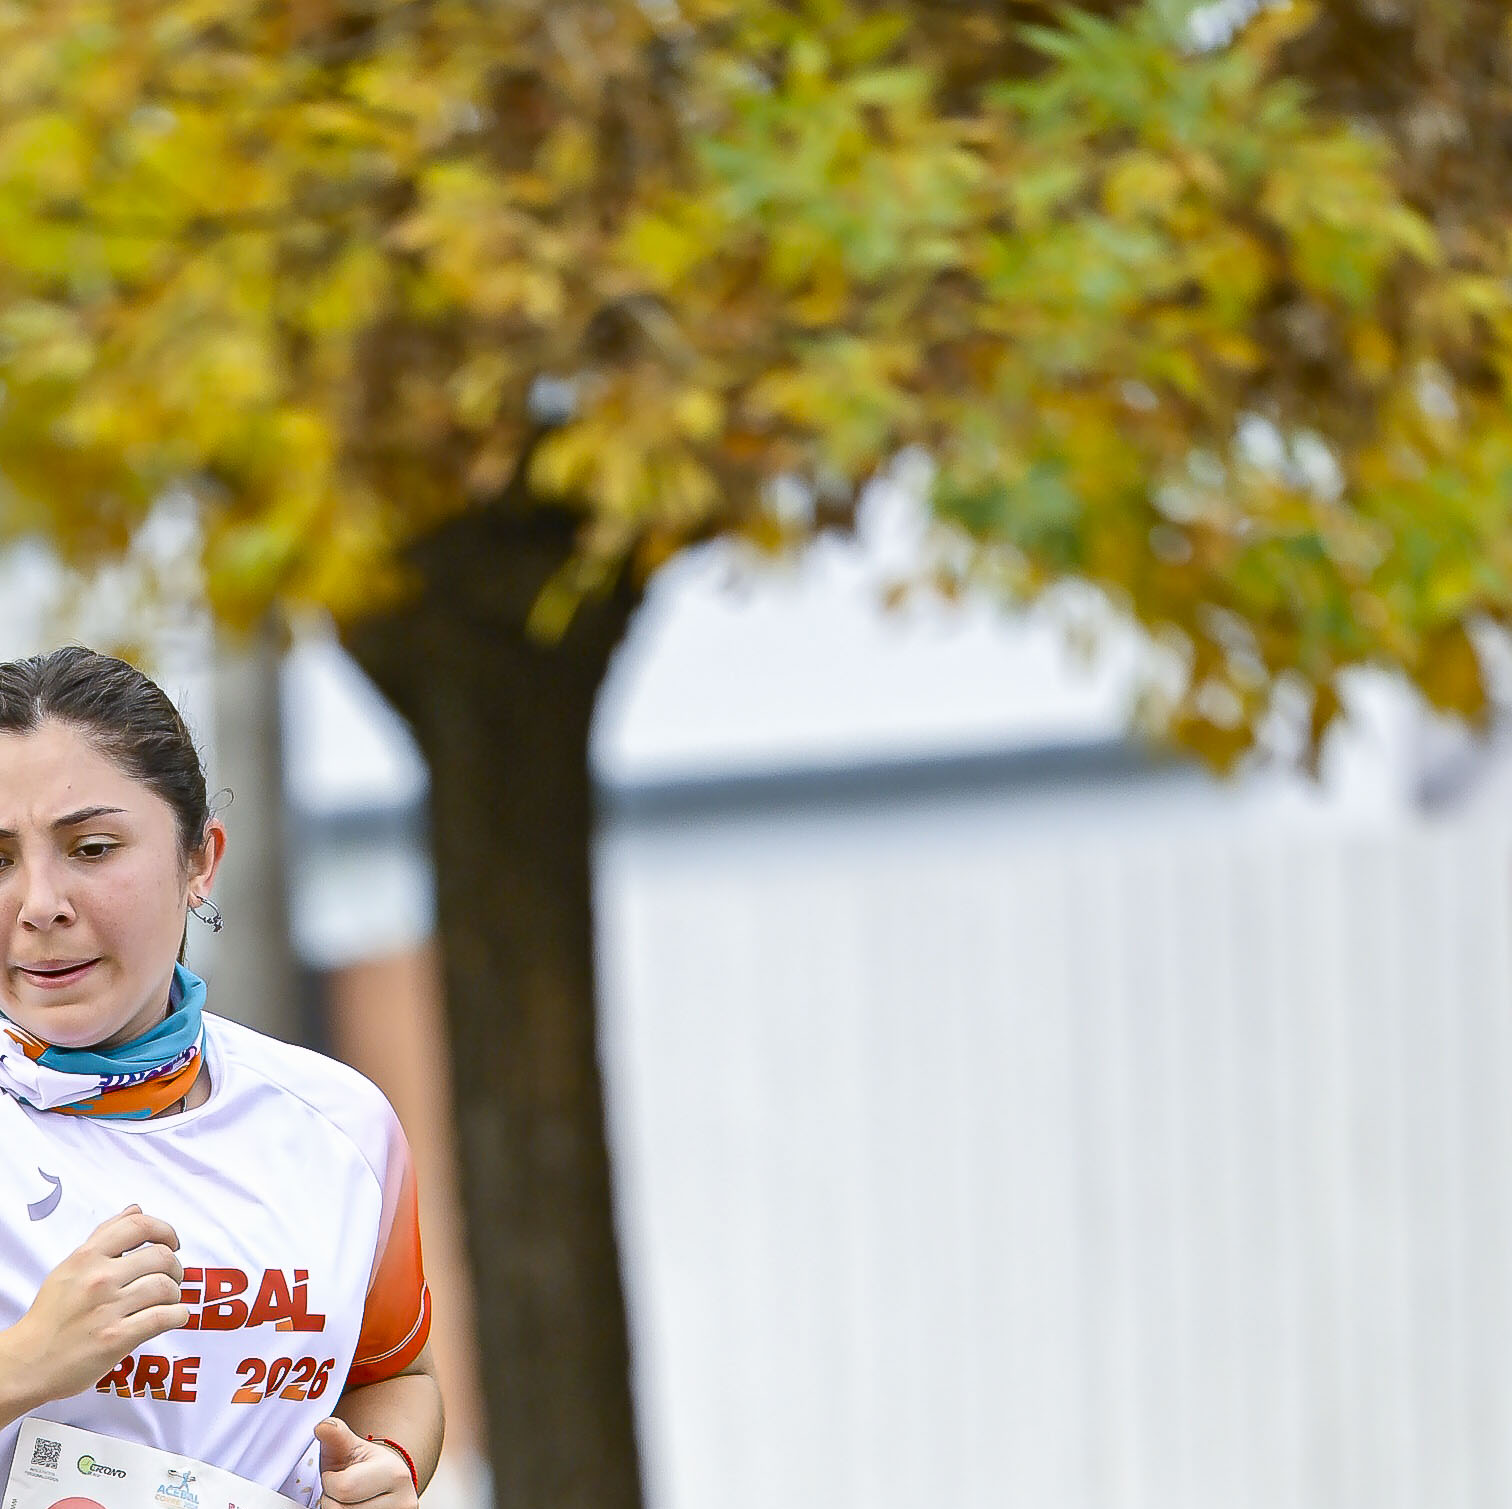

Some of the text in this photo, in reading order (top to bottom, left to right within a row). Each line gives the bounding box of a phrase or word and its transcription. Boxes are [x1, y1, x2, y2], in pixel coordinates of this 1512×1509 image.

[175, 1267, 326, 1333] EBAL
[95, 1354, 336, 1404] RRE 2026
